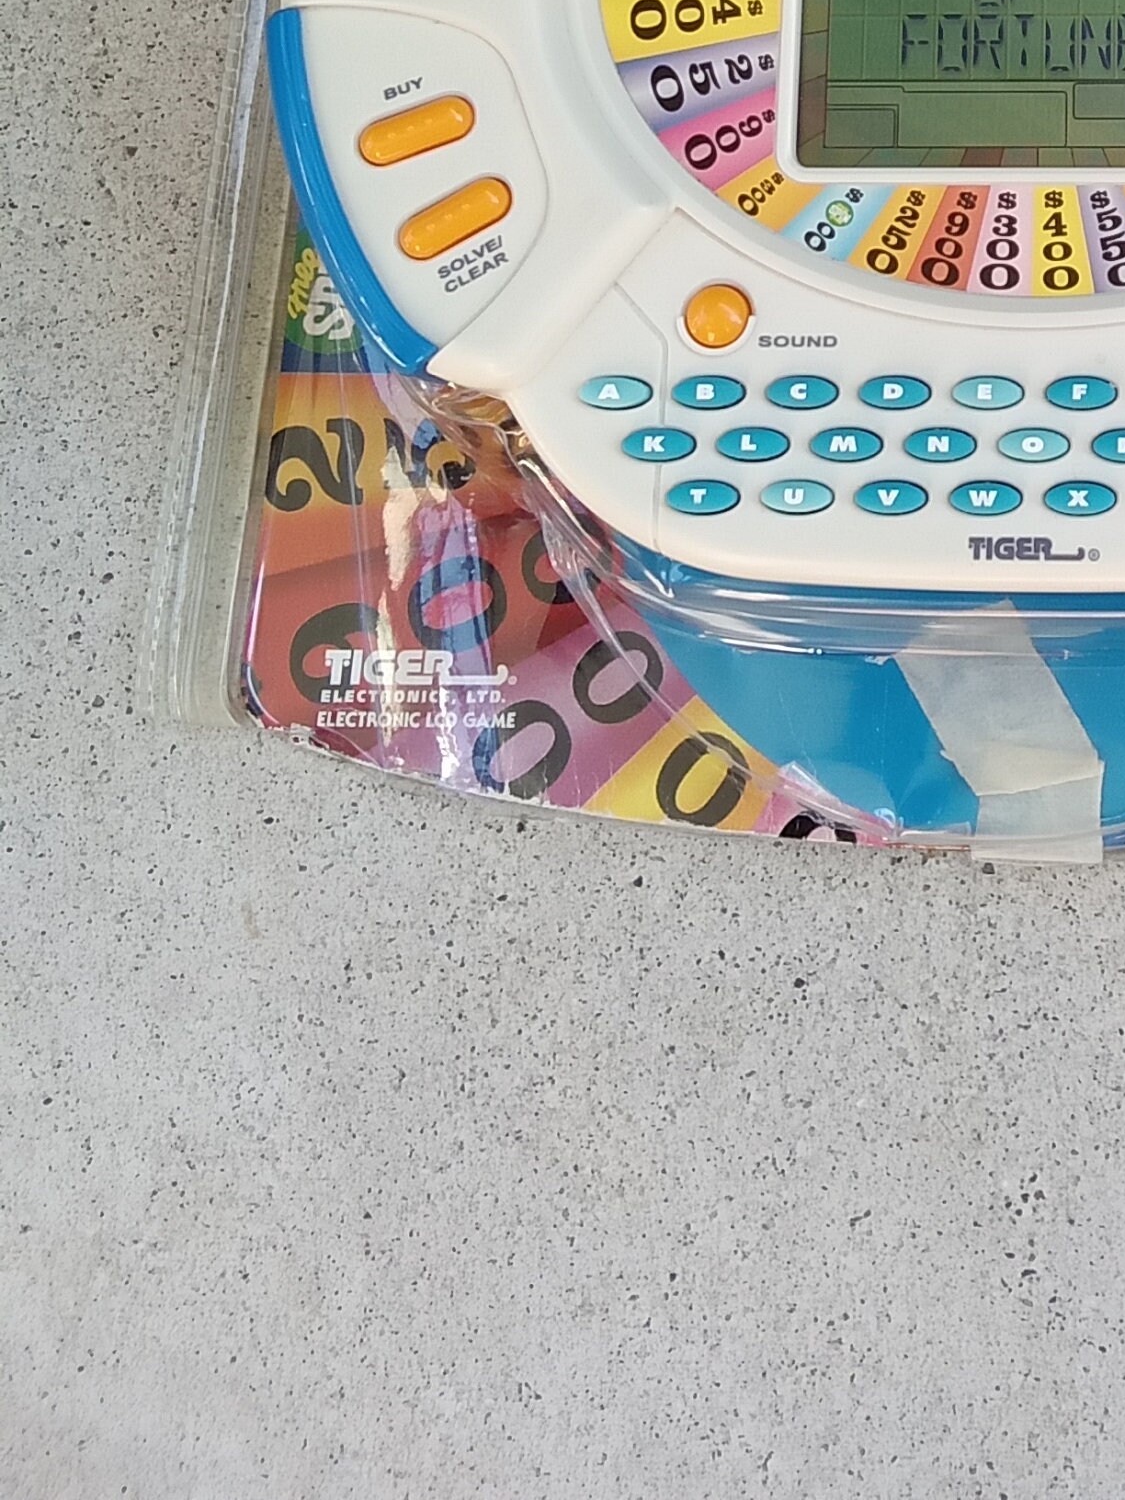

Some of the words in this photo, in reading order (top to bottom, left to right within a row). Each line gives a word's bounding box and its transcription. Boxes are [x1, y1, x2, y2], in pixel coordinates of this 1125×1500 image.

[383, 77, 424, 100] BUY
[650, 54, 775, 113] $250
[866, 190, 926, 276] $250
[920, 190, 979, 288] $900
[979, 190, 1021, 291] $300
[1042, 190, 1081, 291] $400
[437, 235, 503, 281] SOLVE/
[443, 251, 509, 295] CLEAR
[758, 334, 839, 349] SOUND
[598, 384, 620, 400] A
[695, 384, 715, 401] B
[789, 383, 808, 400] C
[882, 384, 904, 400] D
[976, 384, 993, 400] E
[1071, 384, 1088, 401] F
[643, 436, 665, 453] K
[740, 435, 757, 451] L
[829, 436, 858, 453] M
[927, 436, 950, 453] N
[1021, 437, 1044, 454] O
[689, 489, 706, 504] T
[784, 489, 804, 504] U
[877, 490, 899, 506] V
[968, 490, 998, 507] W
[1067, 490, 1089, 507] X
[968, 536, 1086, 562] TIGER
[325, 650, 510, 686] TIGER
[465, 689, 507, 704] LTD.
[316, 710, 420, 729] ELECTRONIC
[462, 711, 517, 729] GAME
